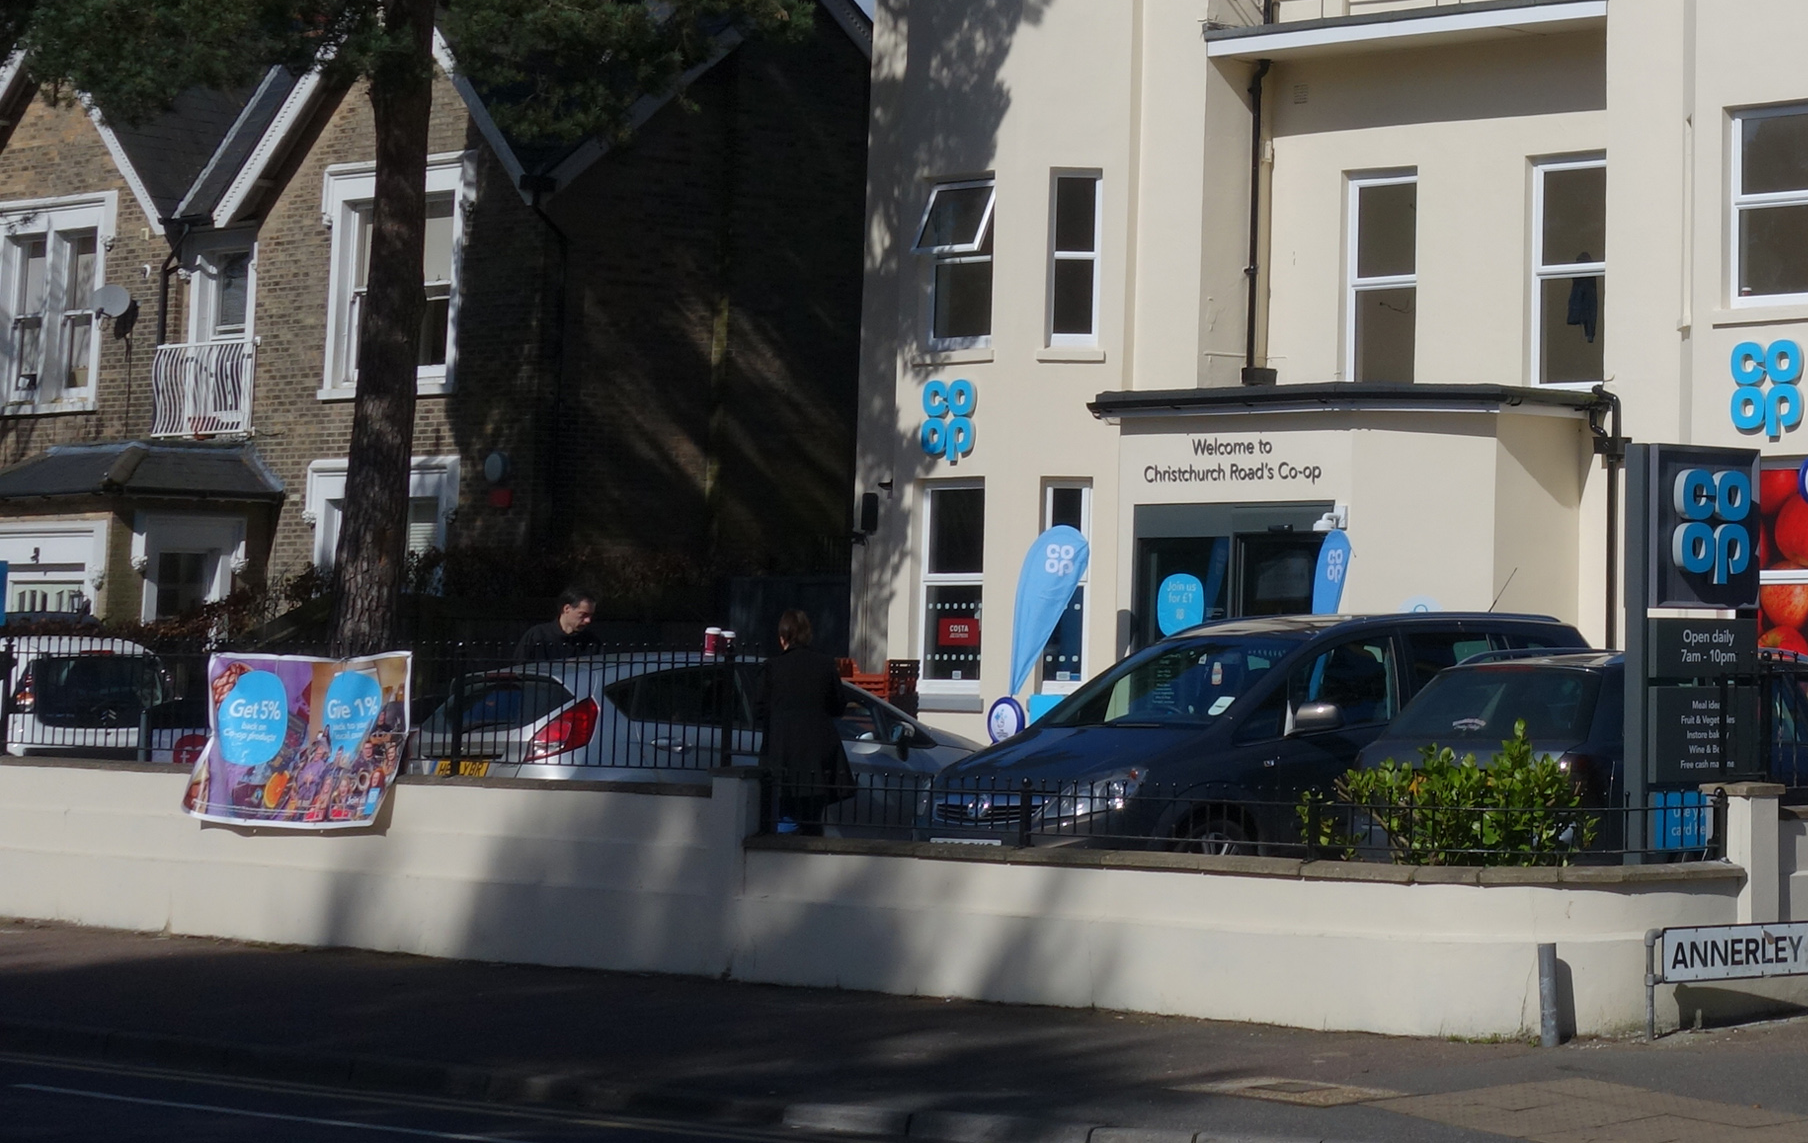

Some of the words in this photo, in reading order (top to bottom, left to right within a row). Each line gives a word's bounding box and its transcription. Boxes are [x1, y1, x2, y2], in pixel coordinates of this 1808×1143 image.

[1192, 438, 1254, 456] Welcome
[1259, 439, 1273, 454] to
[1144, 464, 1226, 483] Christchurch
[1230, 462, 1274, 481] Road's
[1278, 461, 1322, 485] Co-op
[1167, 581, 1185, 592] Join
[1186, 584, 1197, 592] us
[1168, 592, 1181, 603] for
[949, 625, 969, 633] COSTA
[1683, 629, 1710, 646] Open
[1712, 629, 1735, 646] daily
[1681, 649, 1701, 662] 7am
[1710, 649, 1736, 666] 10pm
[228, 699, 258, 719] Get
[260, 700, 281, 720] 5%
[327, 698, 351, 719] Gie
[354, 696, 379, 716] 1%
[1692, 700, 1707, 709] Meal
[1681, 715, 1695, 724] Fruit
[1696, 715, 1701, 724] &
[1702, 715, 1735, 726] Vegetles
[1687, 730, 1707, 739] Instore
[1689, 745, 1705, 754] Wine
[1706, 745, 1711, 753] &
[1680, 760, 1694, 769] Free
[1695, 760, 1708, 768] cash
[1672, 935, 1803, 970] ANNERLEY
